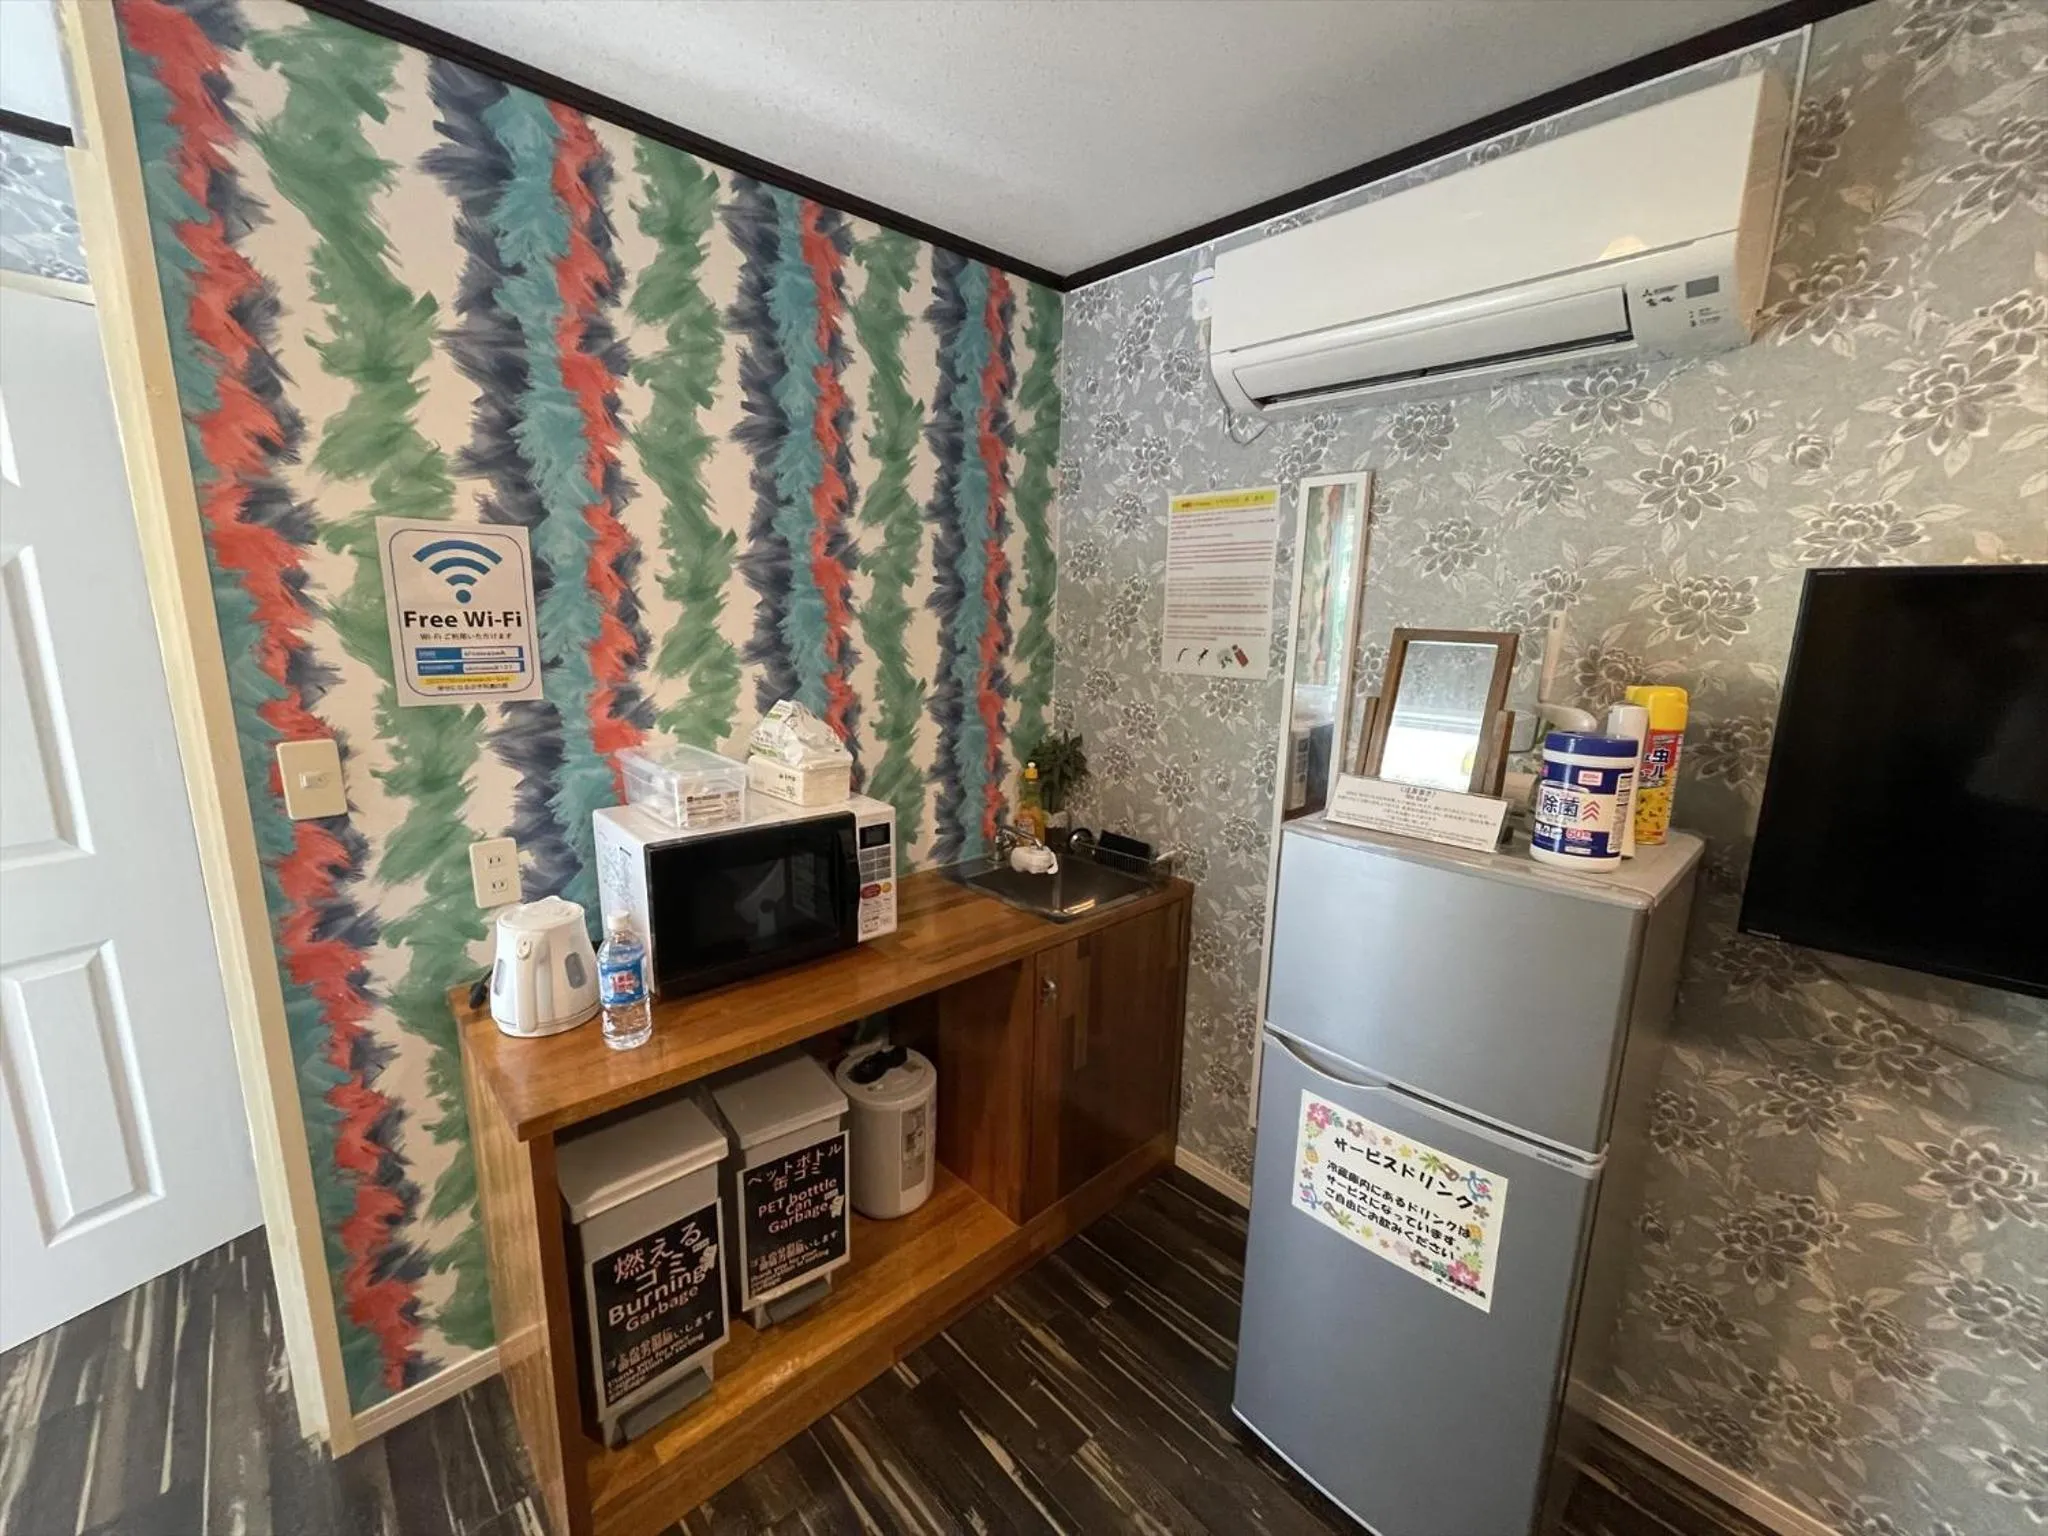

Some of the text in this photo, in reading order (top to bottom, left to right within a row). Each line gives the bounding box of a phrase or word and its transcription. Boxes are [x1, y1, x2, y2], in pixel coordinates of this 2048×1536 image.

[403, 610, 522, 628] Free Wi-Fi
[1543, 793, 1580, 818] 除菌
[1334, 1137, 1473, 1210] サービスドリンク
[758, 1196, 785, 1218] PET
[768, 1201, 828, 1234] Garbage
[1326, 1159, 1471, 1239] 冷蔵庫内にあるドリンクは
[1326, 1174, 1461, 1250] サービスになっています。
[613, 1221, 701, 1285] 燃える
[635, 1252, 687, 1293] ゴミ
[608, 1264, 706, 1327] Burning
[625, 1285, 699, 1332] Garbage
